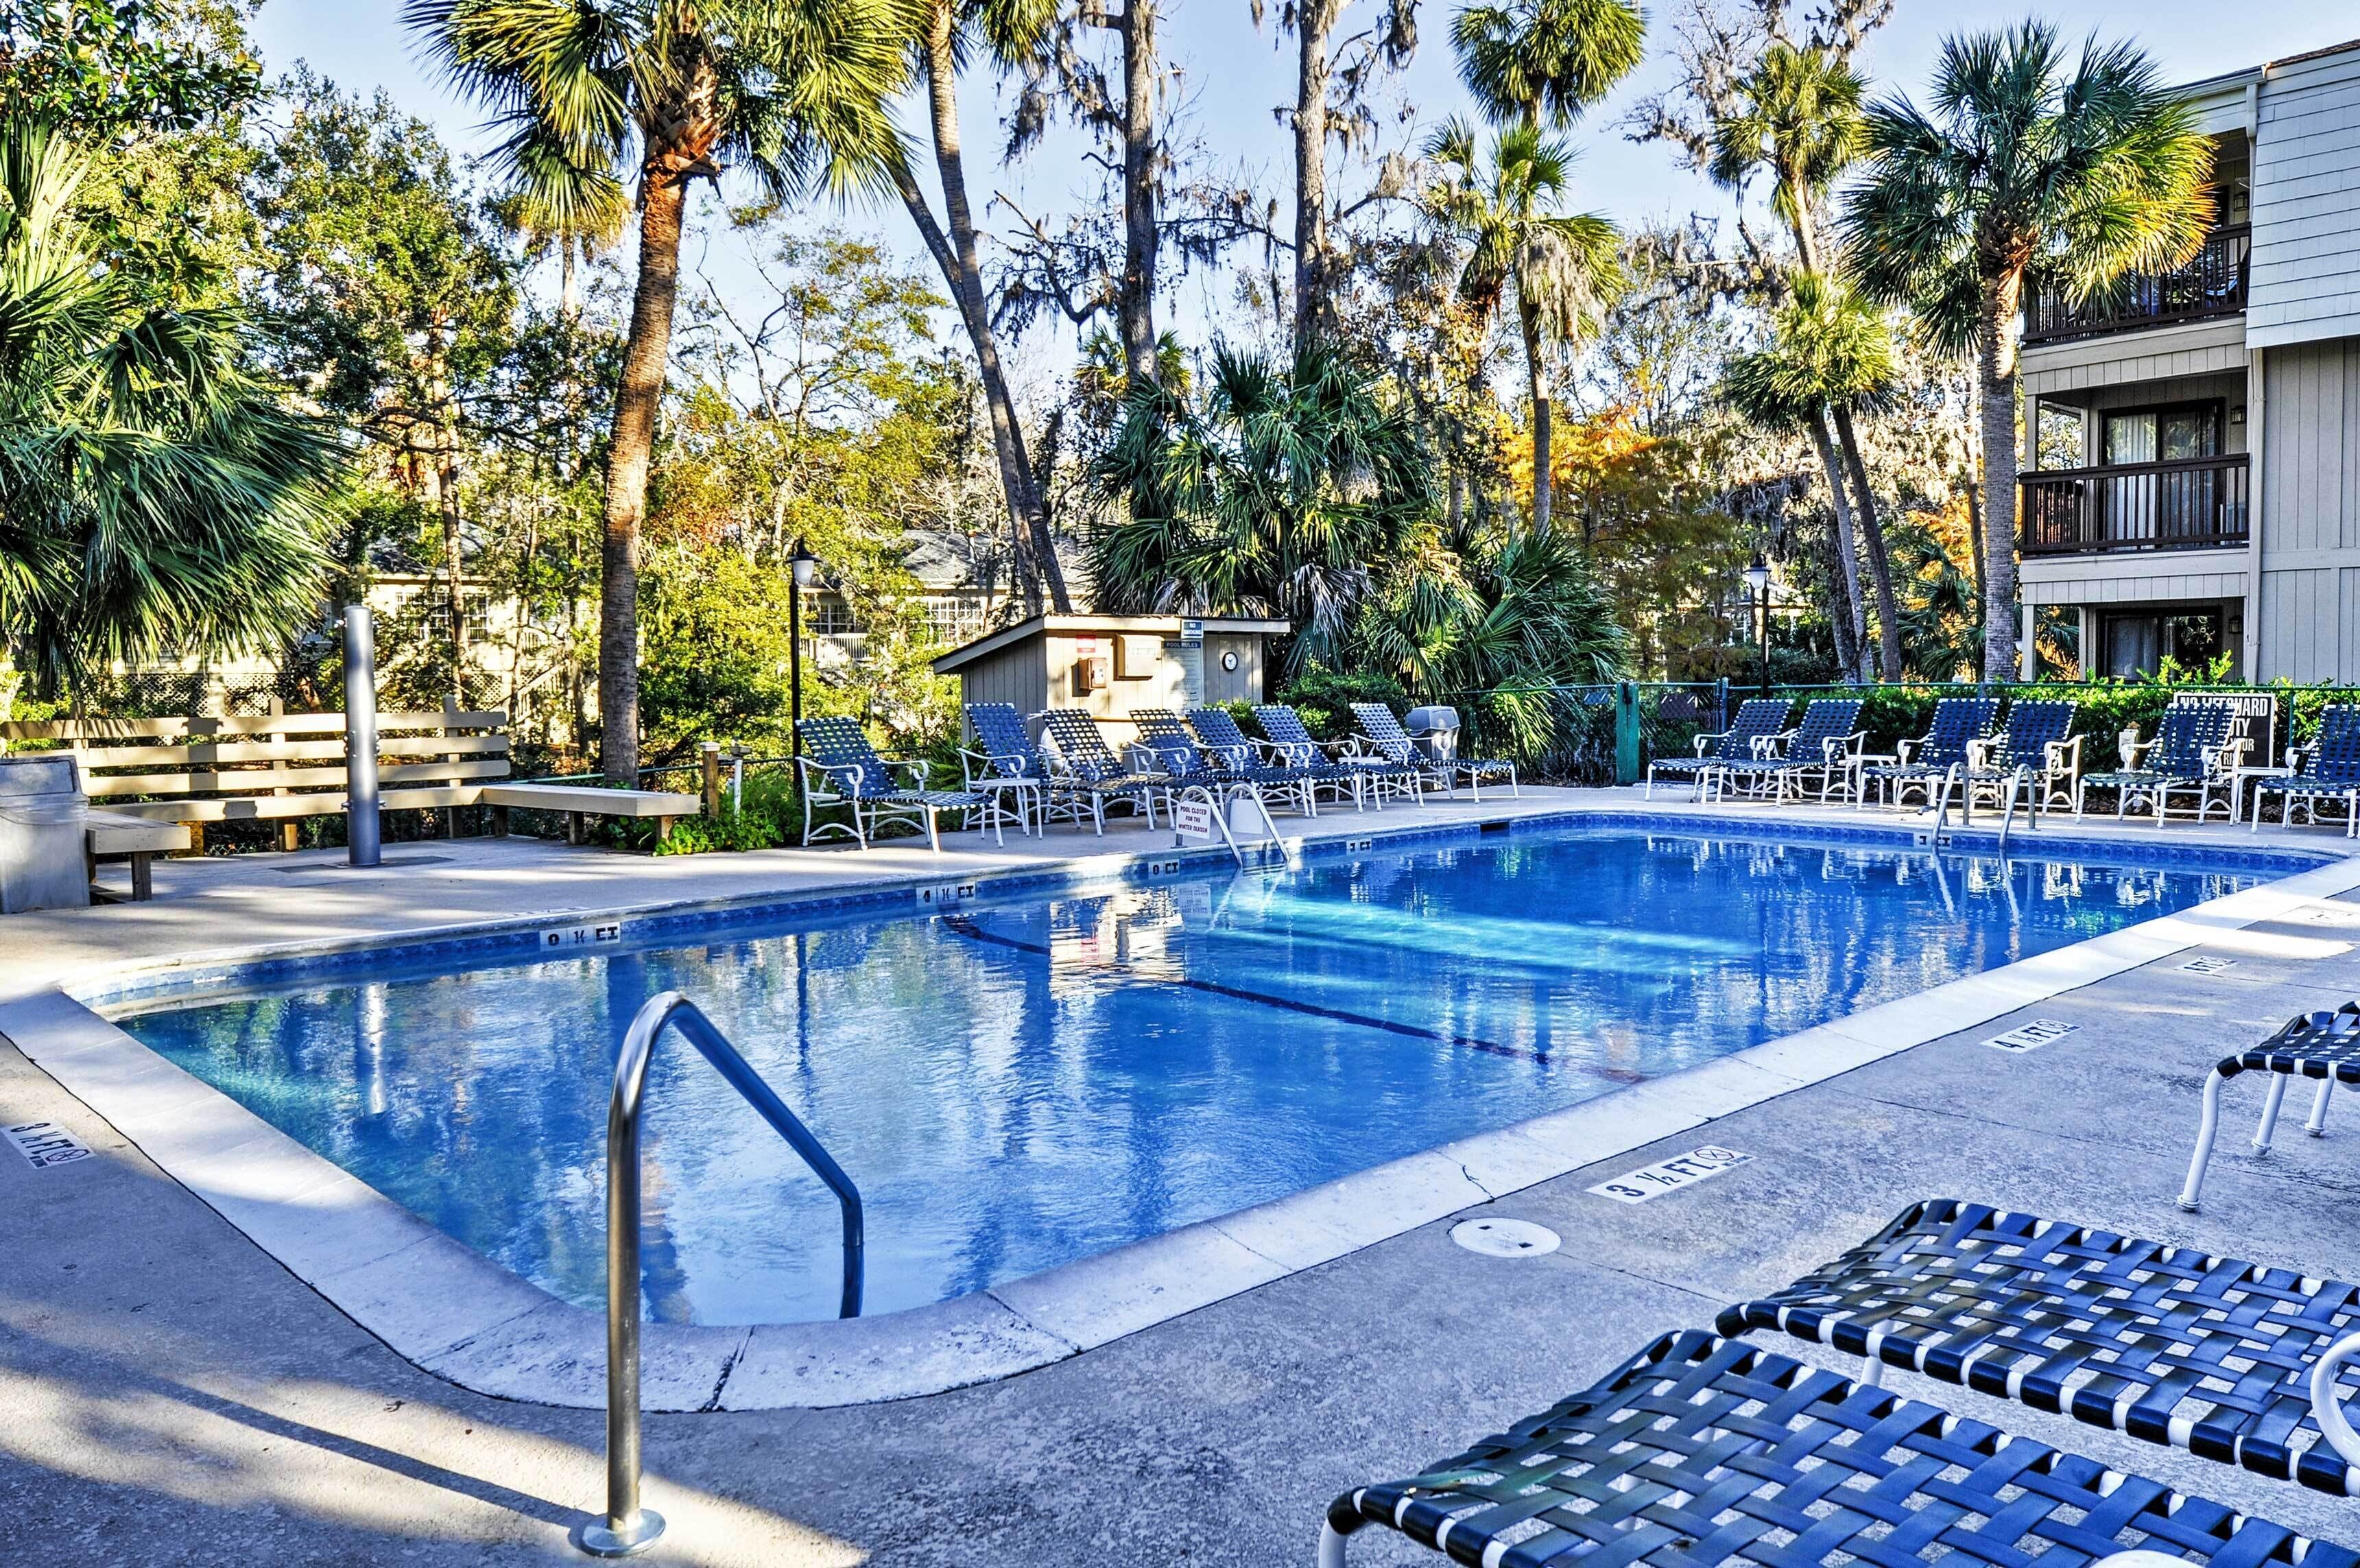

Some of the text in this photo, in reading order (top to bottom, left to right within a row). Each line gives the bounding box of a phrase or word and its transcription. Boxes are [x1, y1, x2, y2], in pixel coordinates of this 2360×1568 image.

[2223, 752, 2244, 765] RIK
[10, 1123, 51, 1132] 3
[1606, 1185, 1645, 1197] 3
